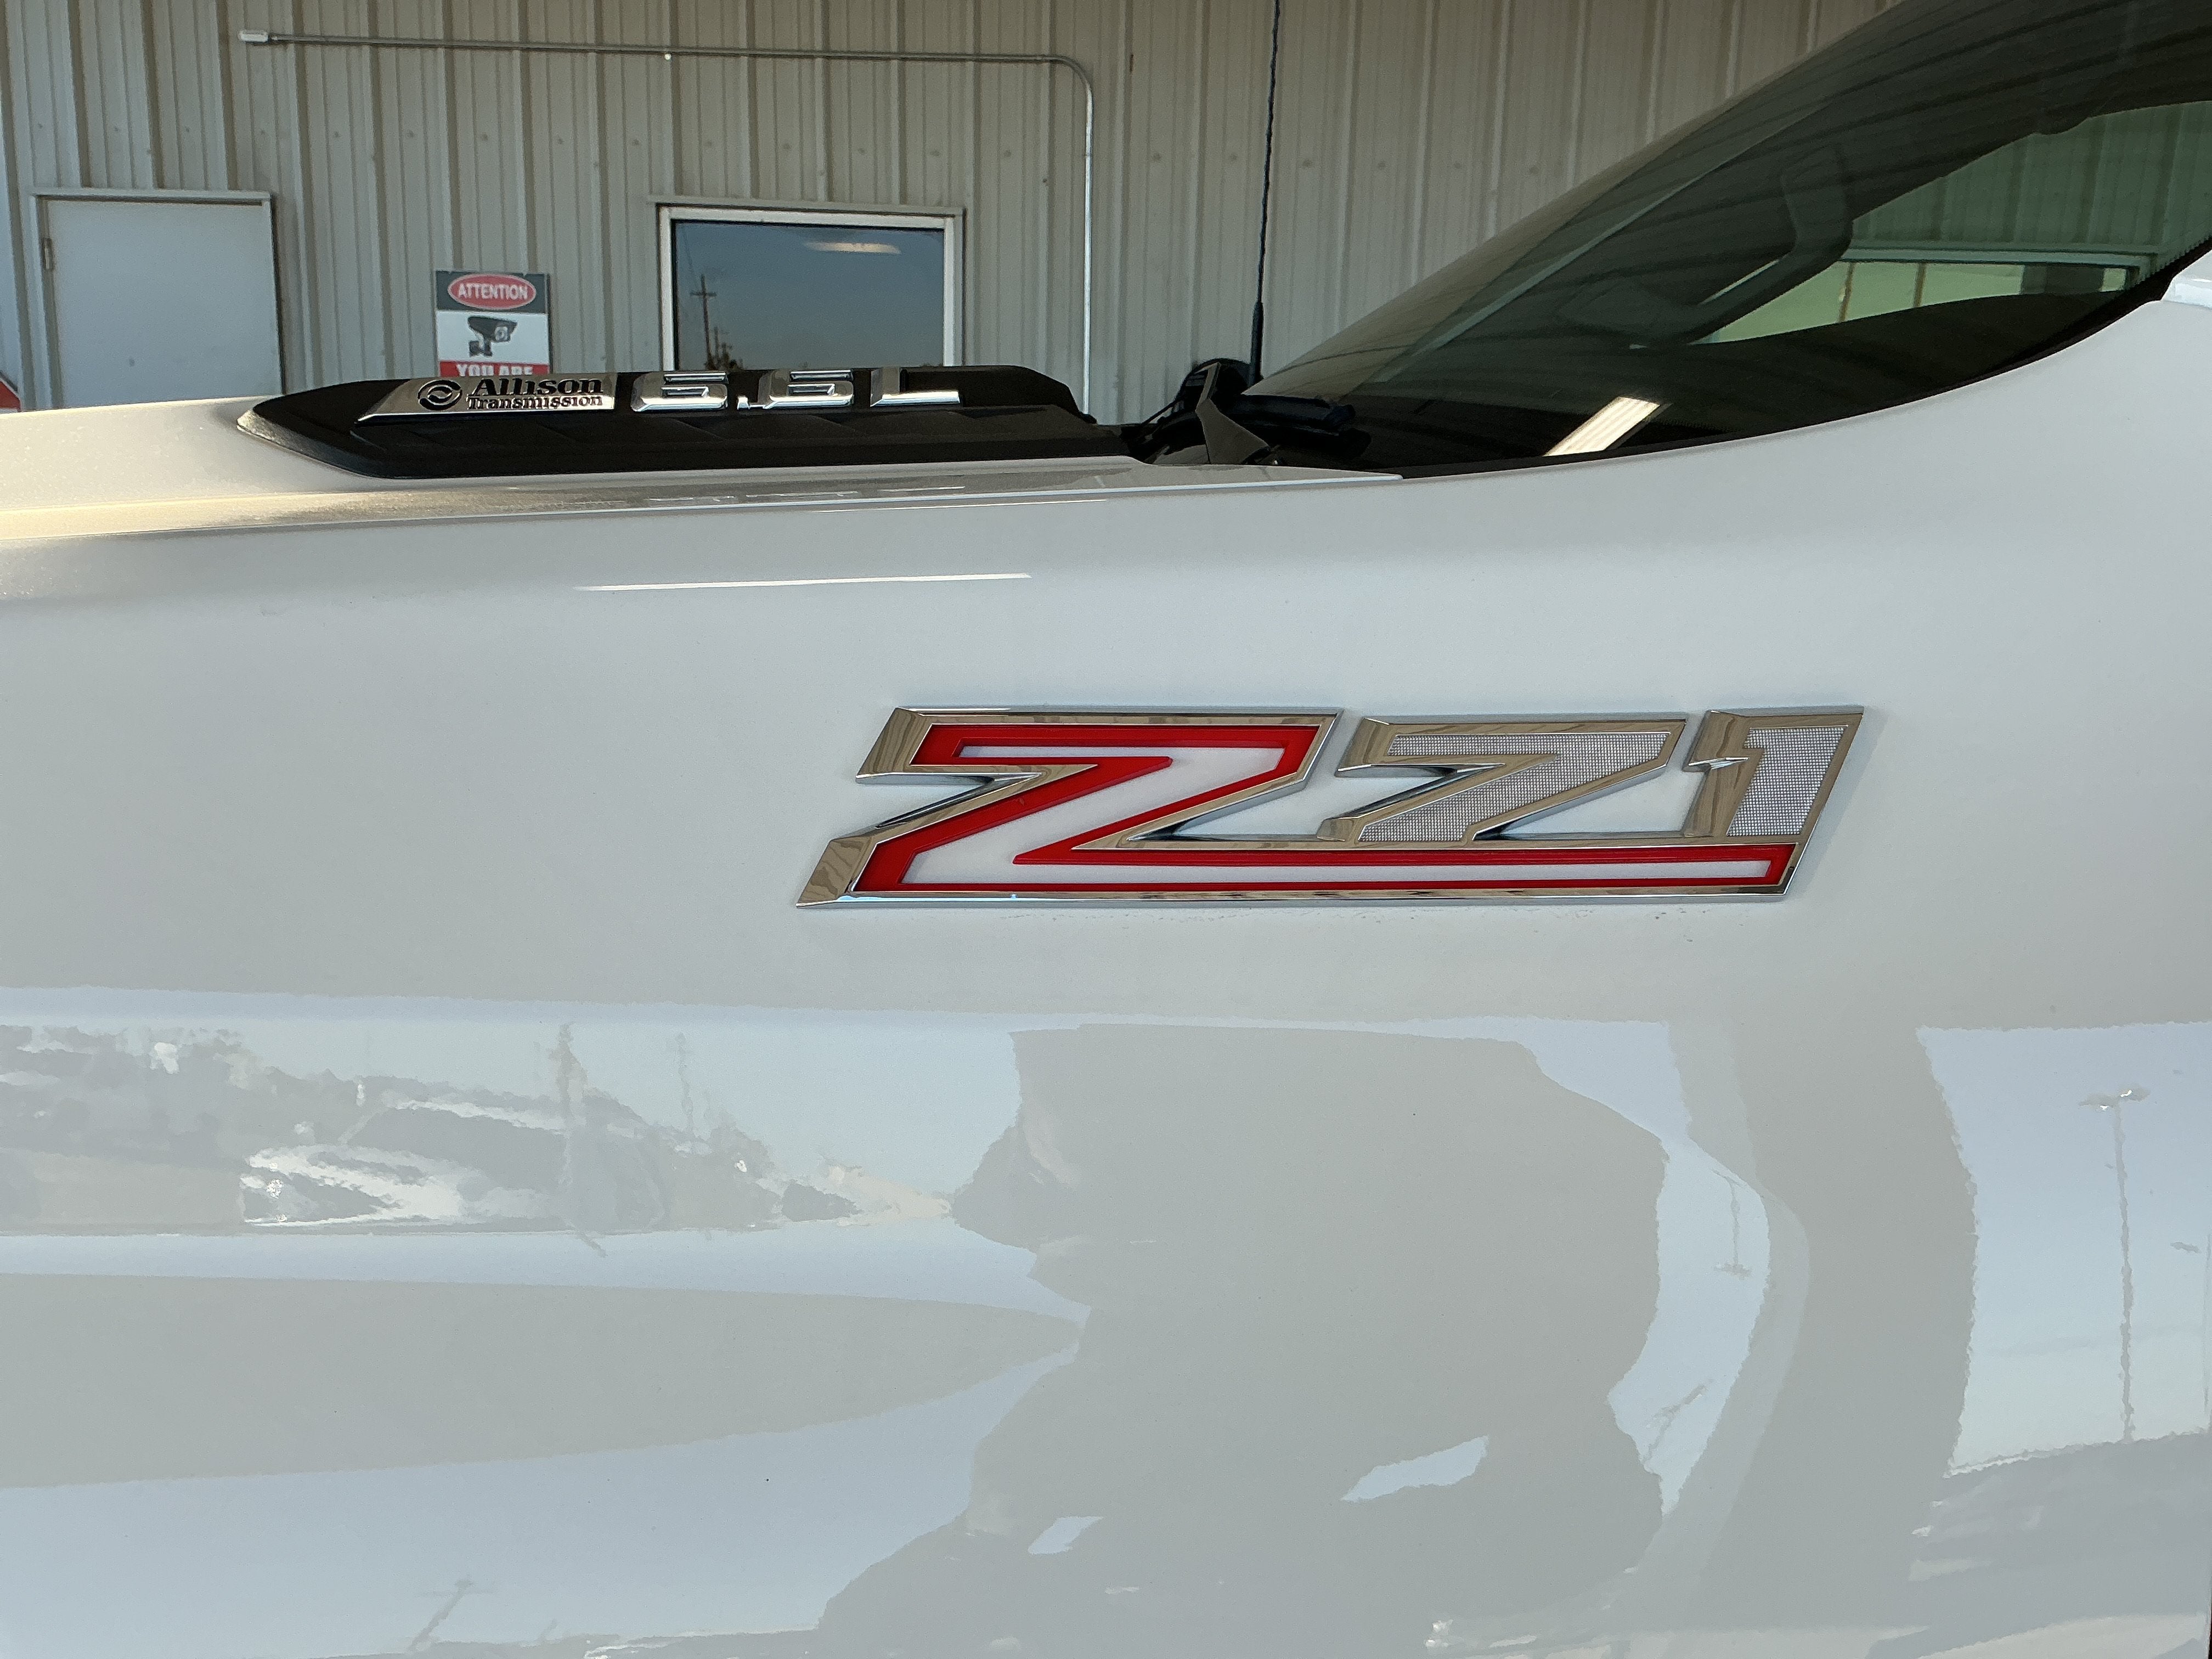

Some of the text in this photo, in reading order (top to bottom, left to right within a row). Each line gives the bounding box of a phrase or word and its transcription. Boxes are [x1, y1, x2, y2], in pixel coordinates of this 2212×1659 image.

[458, 283, 528, 300] ATTENTION
[470, 377, 603, 396] Allison
[631, 369, 961, 412] 6.6L
[467, 394, 603, 410] Transmission
[795, 706, 1865, 909] Z71
